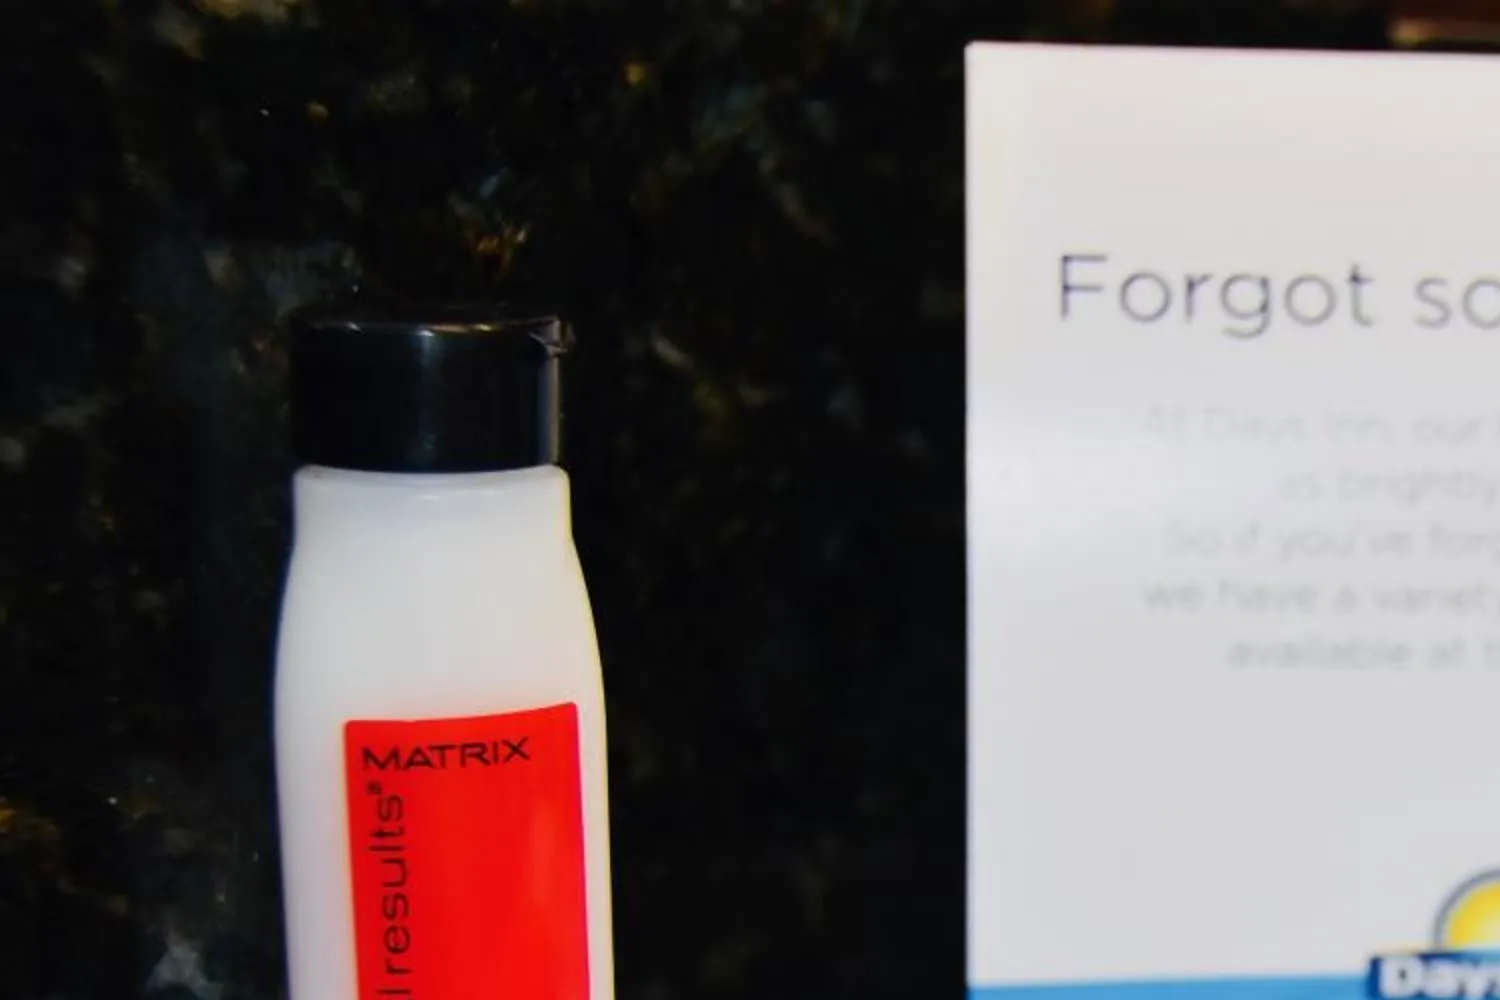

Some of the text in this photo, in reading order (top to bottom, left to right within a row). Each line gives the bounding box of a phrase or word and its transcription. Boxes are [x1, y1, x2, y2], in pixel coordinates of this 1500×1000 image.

[1057, 254, 1376, 339] Forgot
[1202, 405, 1305, 447] Days
[1411, 416, 1482, 447] our
[1279, 473, 1322, 503] as
[1337, 468, 1499, 510] brightly
[1165, 522, 1221, 559] So
[1235, 520, 1262, 556] if
[1277, 521, 1415, 564] you've
[1142, 583, 1205, 615] we
[1218, 578, 1317, 614] have
[1331, 585, 1360, 615] a
[1227, 633, 1413, 670] available
[1427, 636, 1467, 670] at
[361, 737, 532, 772] MATRIX
